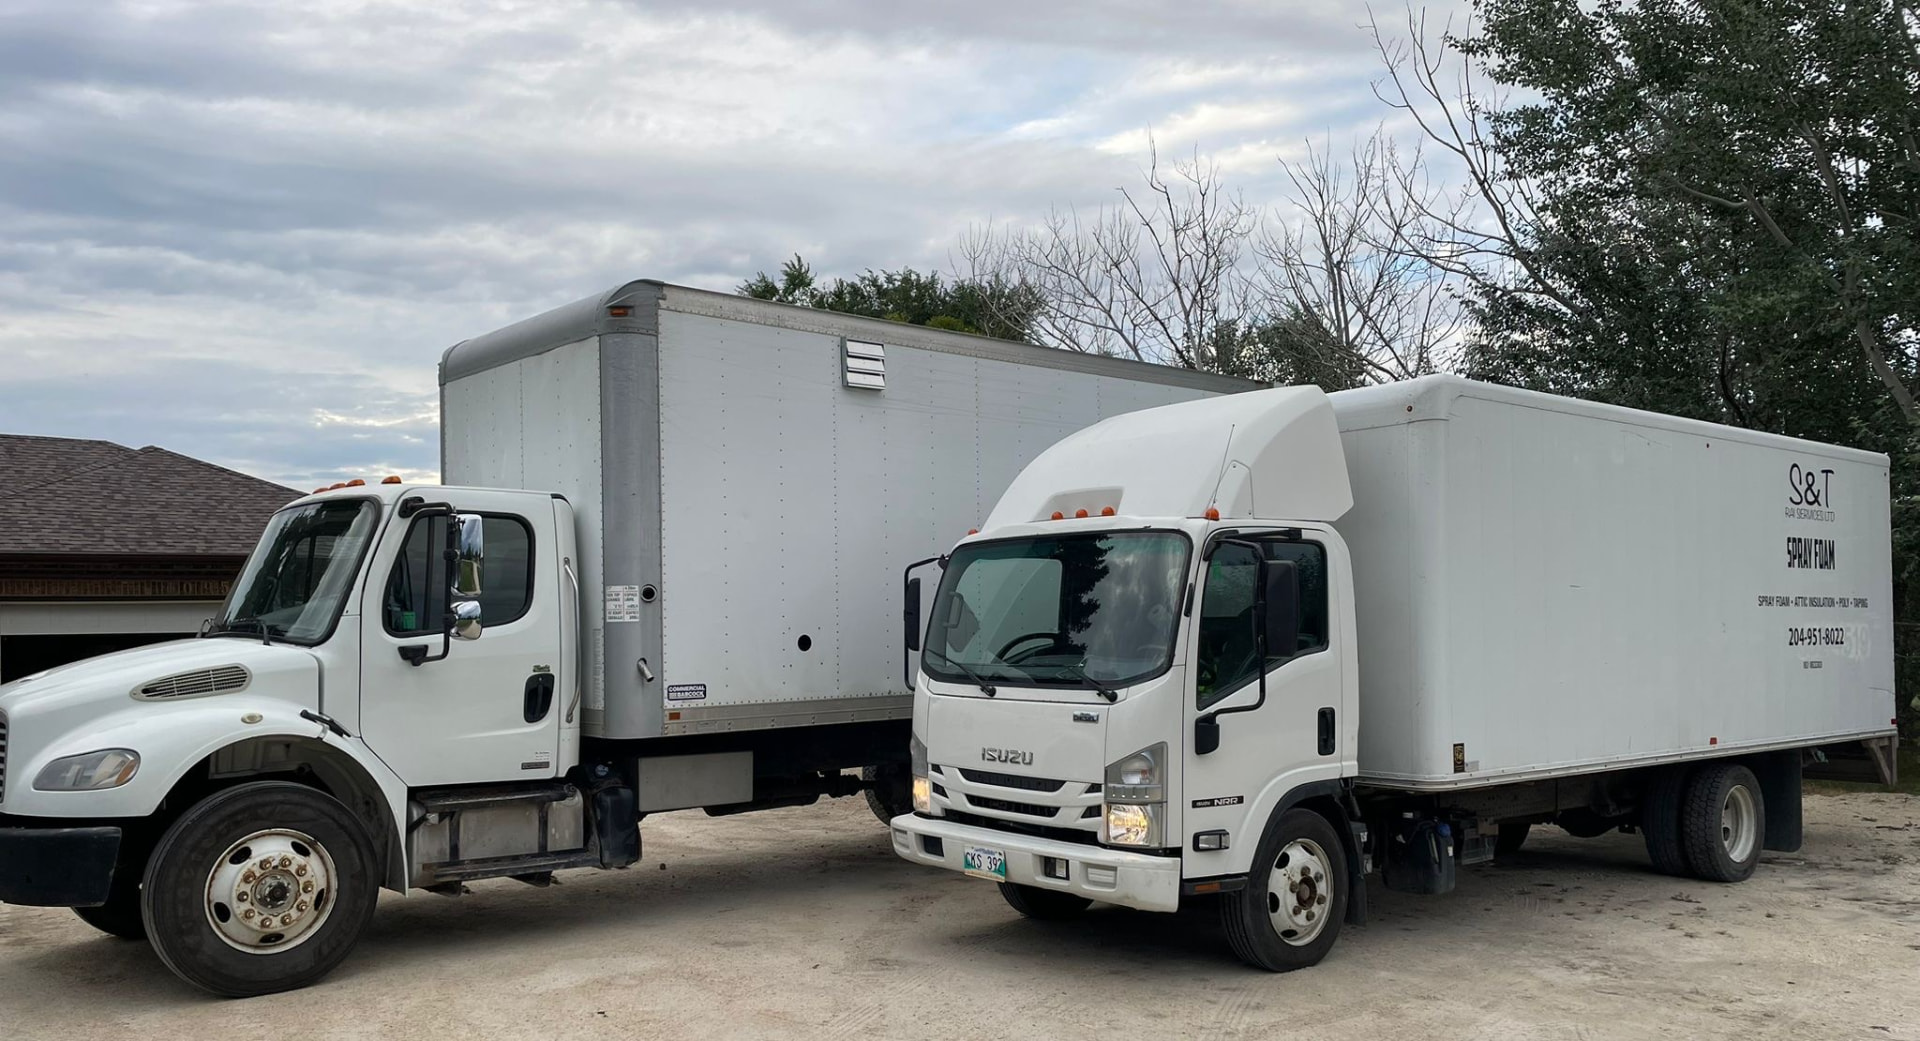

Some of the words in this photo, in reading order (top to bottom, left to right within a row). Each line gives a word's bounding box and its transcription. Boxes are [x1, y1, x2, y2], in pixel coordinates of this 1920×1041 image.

[1789, 462, 1834, 508] S&T
[1796, 507, 1824, 521] SERVICES
[1824, 511, 1836, 522] LTD
[1786, 536, 1813, 569] SPRAY
[1813, 538, 1836, 570] FOAM
[1758, 595, 1775, 607] SPRAY
[1775, 596, 1790, 607] FOAM
[1794, 596, 1808, 607] ATTIC
[1808, 597, 1836, 608] INSULATION
[1838, 597, 1850, 608] POLY
[1853, 597, 1869, 608] TAPING
[1788, 627, 1845, 646] 204-951-8022
[981, 746, 1034, 766] ISUZU
[1214, 797, 1238, 806] NRR
[965, 851, 983, 869] CKS
